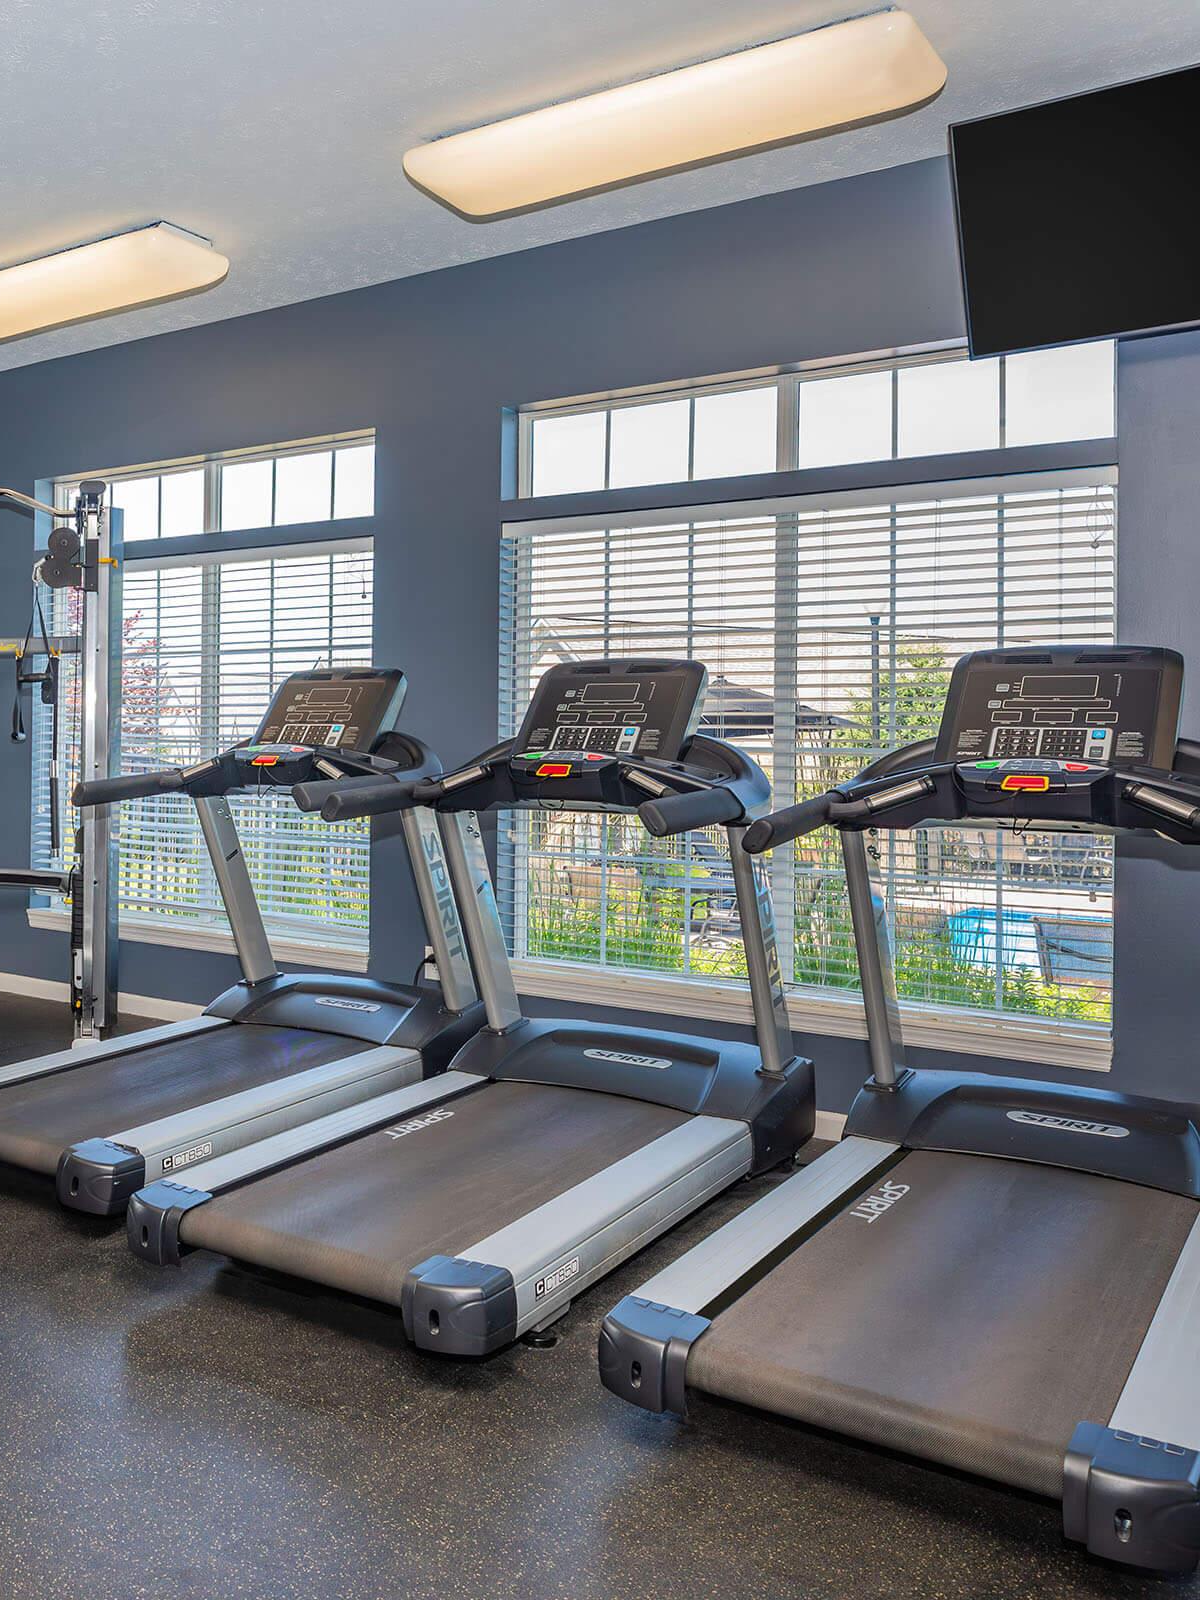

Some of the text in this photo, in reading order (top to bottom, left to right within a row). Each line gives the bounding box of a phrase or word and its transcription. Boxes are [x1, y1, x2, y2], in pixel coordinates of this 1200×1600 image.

[422, 831, 466, 961] SPIRIT
[323, 997, 375, 1011] SPIRIT
[591, 1050, 662, 1065] SPIRIT
[384, 1108, 455, 1140] SPIRIT
[1017, 1112, 1118, 1133] SPIRIT
[849, 1180, 911, 1224] SPIRIT
